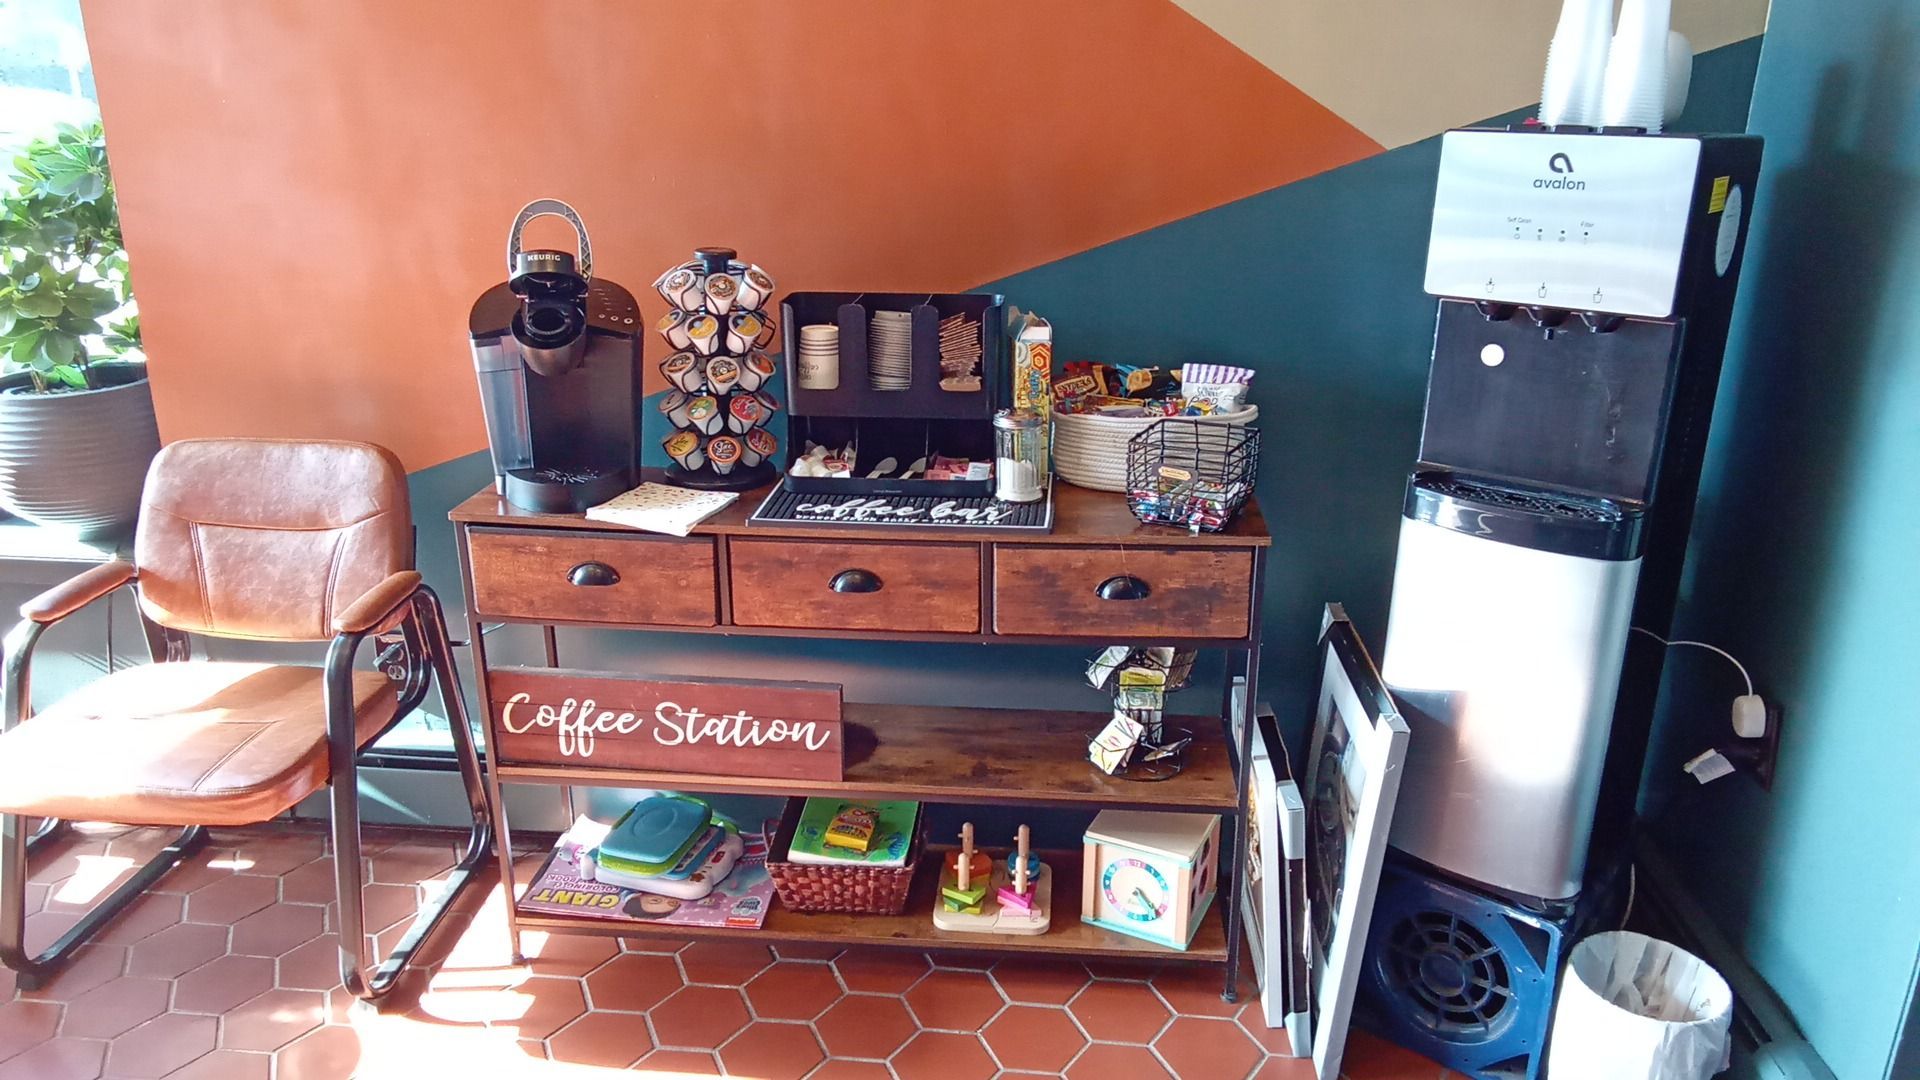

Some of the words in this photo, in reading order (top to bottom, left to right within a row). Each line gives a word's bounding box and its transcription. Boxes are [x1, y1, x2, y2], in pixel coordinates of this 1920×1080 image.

[1533, 176, 1586, 191] avalon
[527, 254, 561, 262] KEURIG
[796, 498, 926, 518] coffee
[930, 501, 1014, 521] bar
[502, 692, 643, 757] Coffee
[653, 701, 831, 751] Station
[531, 888, 621, 910] GIANT
